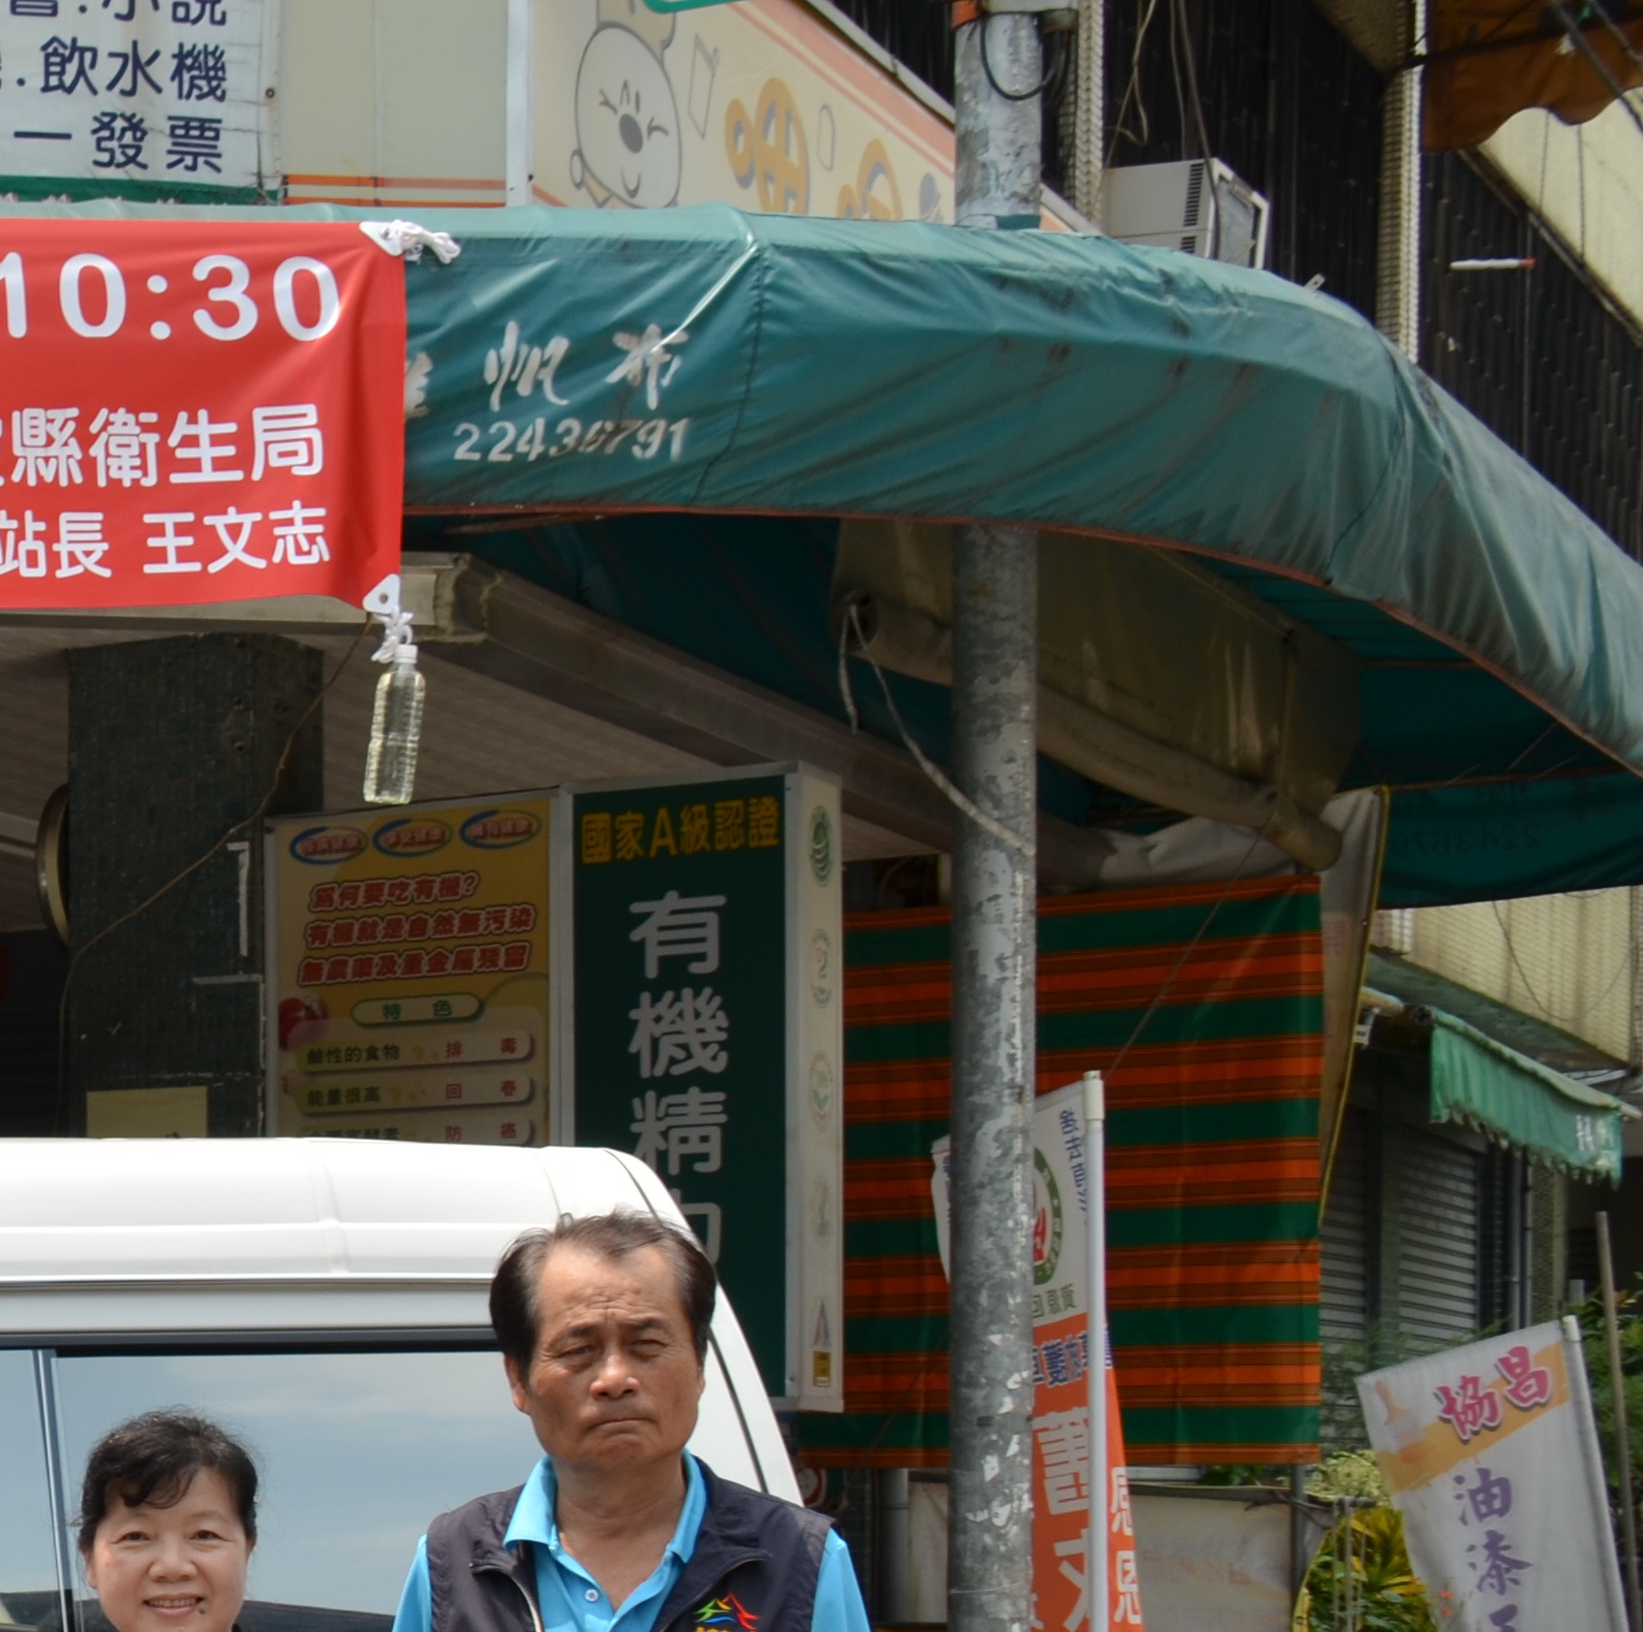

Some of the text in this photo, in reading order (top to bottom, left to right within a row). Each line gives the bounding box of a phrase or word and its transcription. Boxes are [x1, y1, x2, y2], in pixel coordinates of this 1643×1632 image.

[142, 502, 331, 579] 王文志
[581, 796, 780, 864] 國家A級認證
[382, 1000, 452, 1021] 特色
